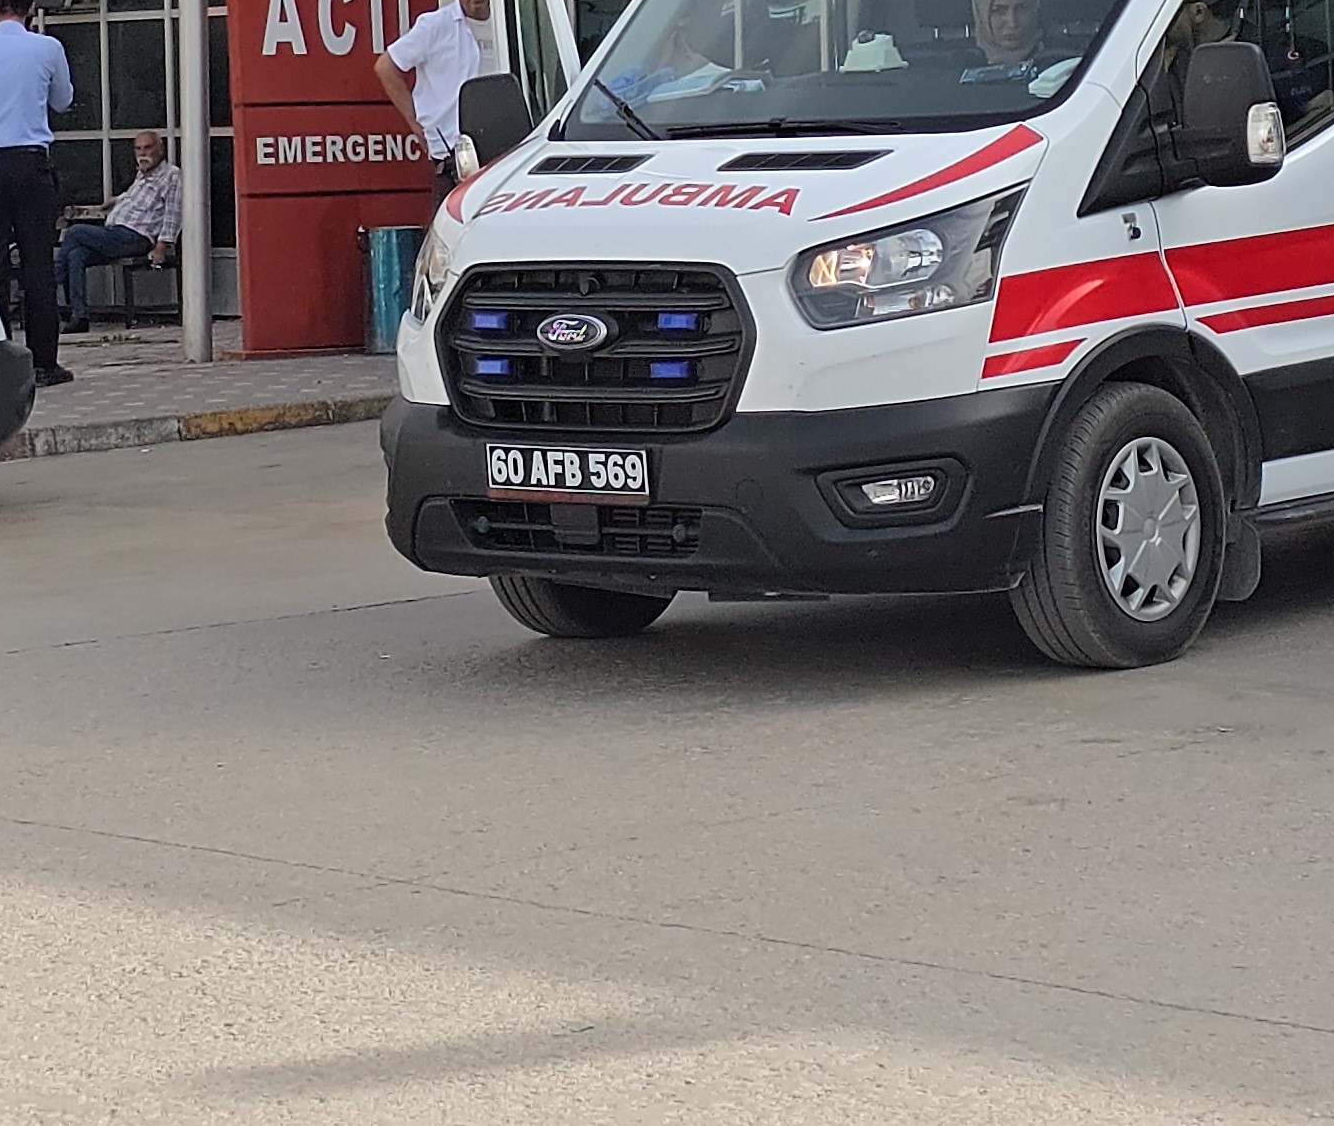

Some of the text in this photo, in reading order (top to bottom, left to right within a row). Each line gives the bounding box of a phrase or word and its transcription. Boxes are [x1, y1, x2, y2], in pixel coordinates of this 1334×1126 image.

[256, 134, 431, 165] EMERGENC
[547, 319, 588, 342] Ford
[491, 448, 644, 490] 60 AFB 569
